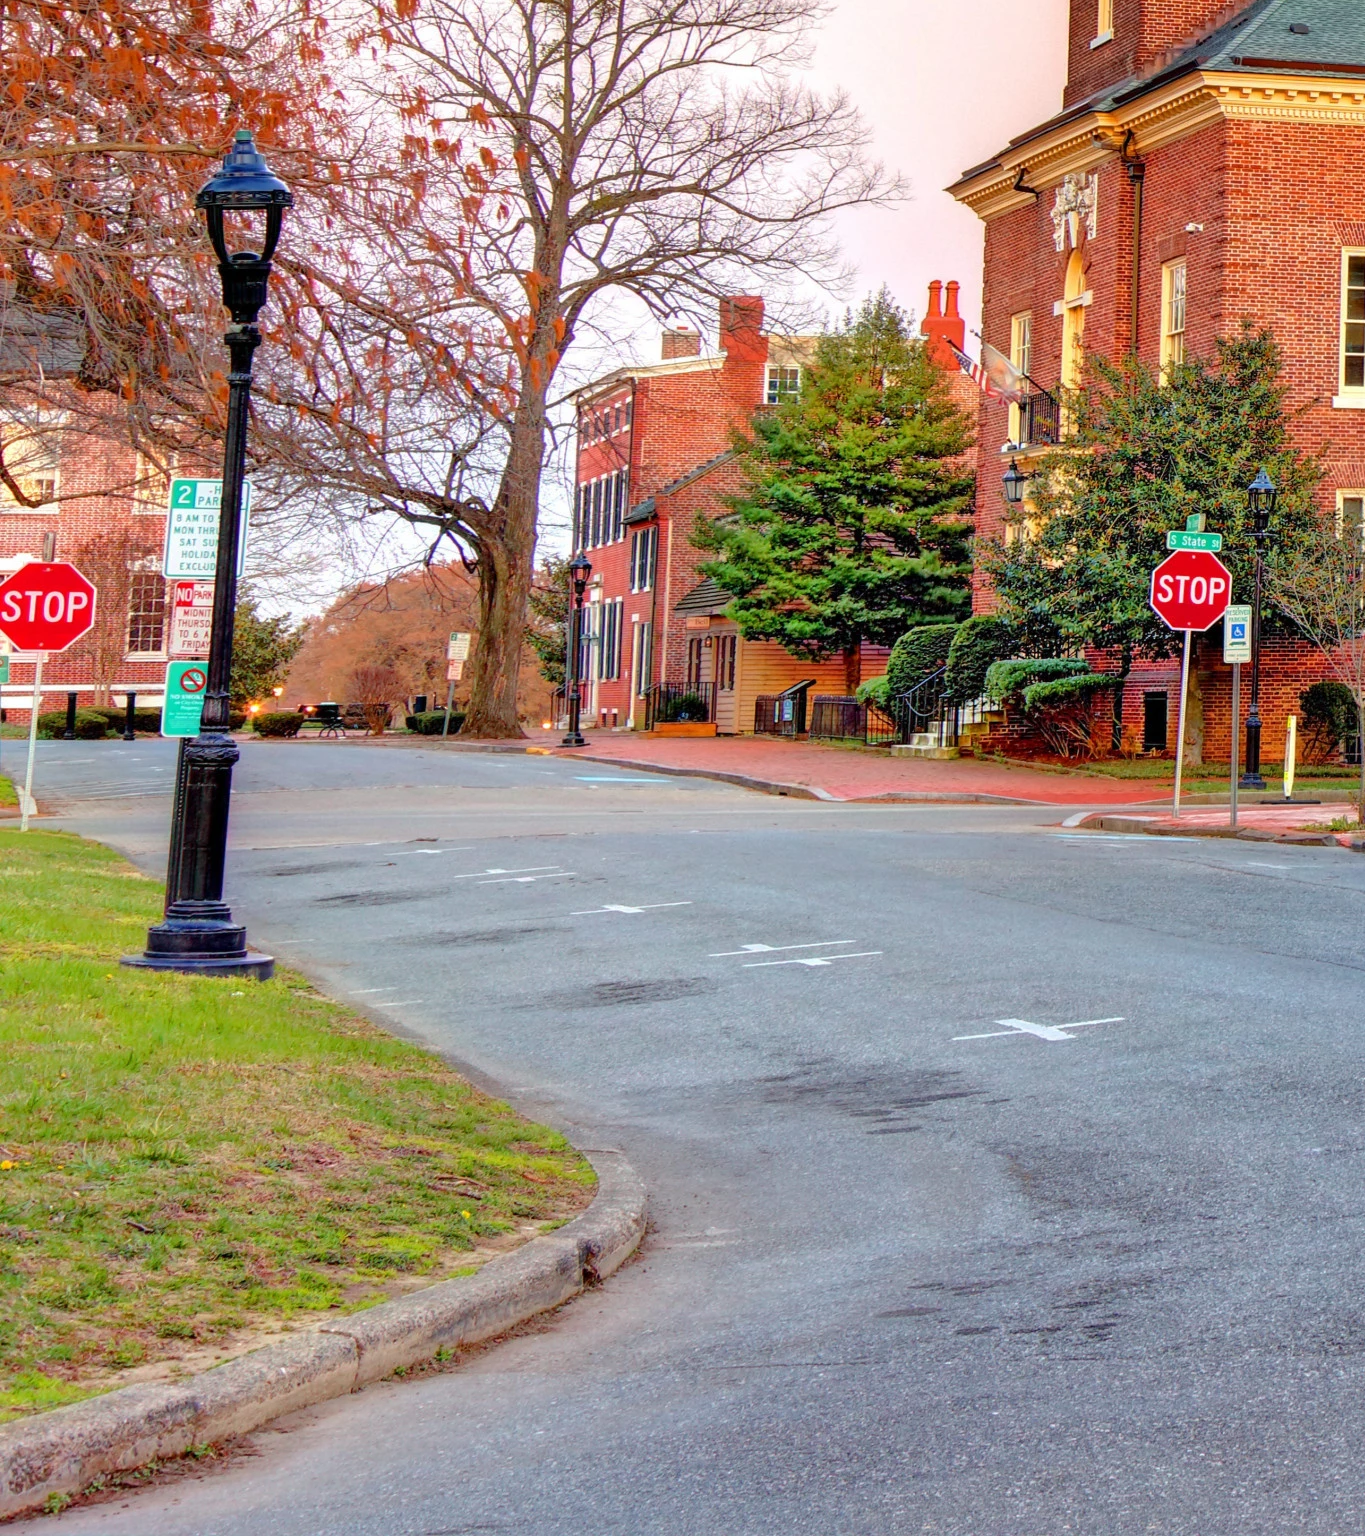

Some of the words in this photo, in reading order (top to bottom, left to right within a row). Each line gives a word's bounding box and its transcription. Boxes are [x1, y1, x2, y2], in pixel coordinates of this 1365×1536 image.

[177, 485, 191, 504] 2
[174, 526, 194, 534] MON
[179, 538, 197, 546] SAT
[1170, 534, 1177, 545] S
[1181, 535, 1207, 547] State
[1211, 539, 1219, 548] St
[181, 550, 216, 558] HOLIDA
[179, 562, 216, 570] EXCLUD
[1157, 574, 1226, 605] STOP
[177, 588, 193, 602] NO
[194, 590, 213, 599] PARK
[1, 590, 89, 623] STOP
[183, 608, 212, 617] MIDNIT
[178, 619, 211, 628] THURSD
[179, 630, 189, 638] TO
[193, 630, 199, 638] 6
